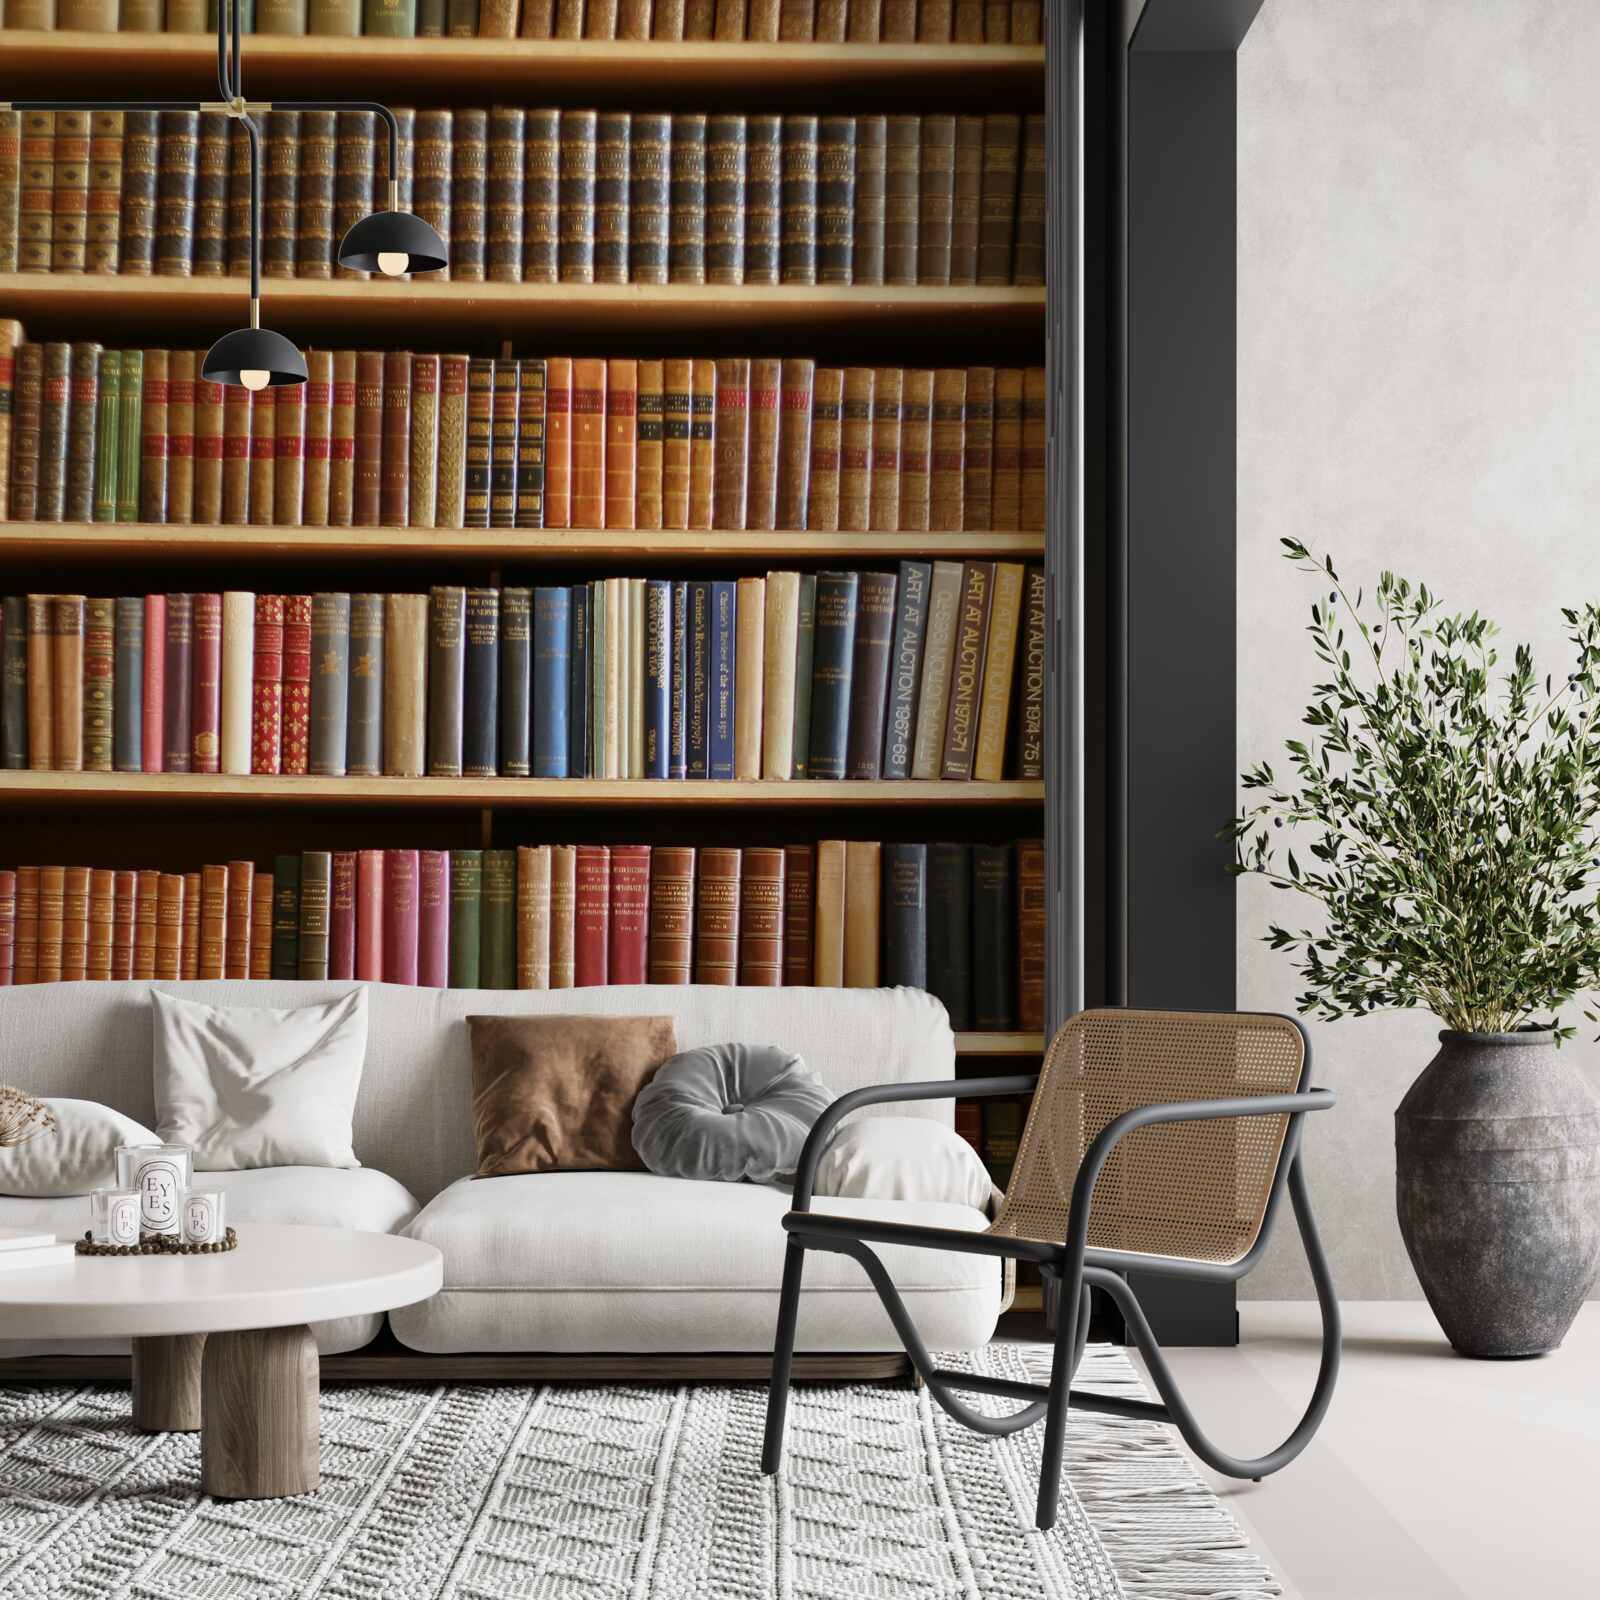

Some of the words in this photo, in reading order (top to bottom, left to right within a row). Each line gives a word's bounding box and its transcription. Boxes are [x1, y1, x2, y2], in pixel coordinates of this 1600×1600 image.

[907, 567, 923, 603] ART
[968, 569, 985, 604] ART
[1001, 571, 1016, 607] ART
[1030, 574, 1046, 610] ART
[695, 588, 705, 631] Christie's
[904, 607, 920, 628] AT
[965, 605, 982, 627] AT
[998, 607, 1013, 627] AT
[1030, 609, 1045, 630] AT
[674, 629, 682, 660] Review
[694, 632, 704, 666] Review
[674, 675, 683, 688] the
[720, 675, 728, 687] the
[896, 629, 917, 701] AUCTION
[956, 627, 978, 701] AUCTION
[990, 627, 1010, 701] AUCTION
[1026, 630, 1045, 701] AUCTION
[673, 688, 681, 709] Year
[694, 692, 704, 714] Year
[720, 688, 728, 718] Season
[892, 705, 910, 765] 1967-68
[951, 703, 970, 752] 1970-71
[1024, 705, 1040, 760] 1974-75
